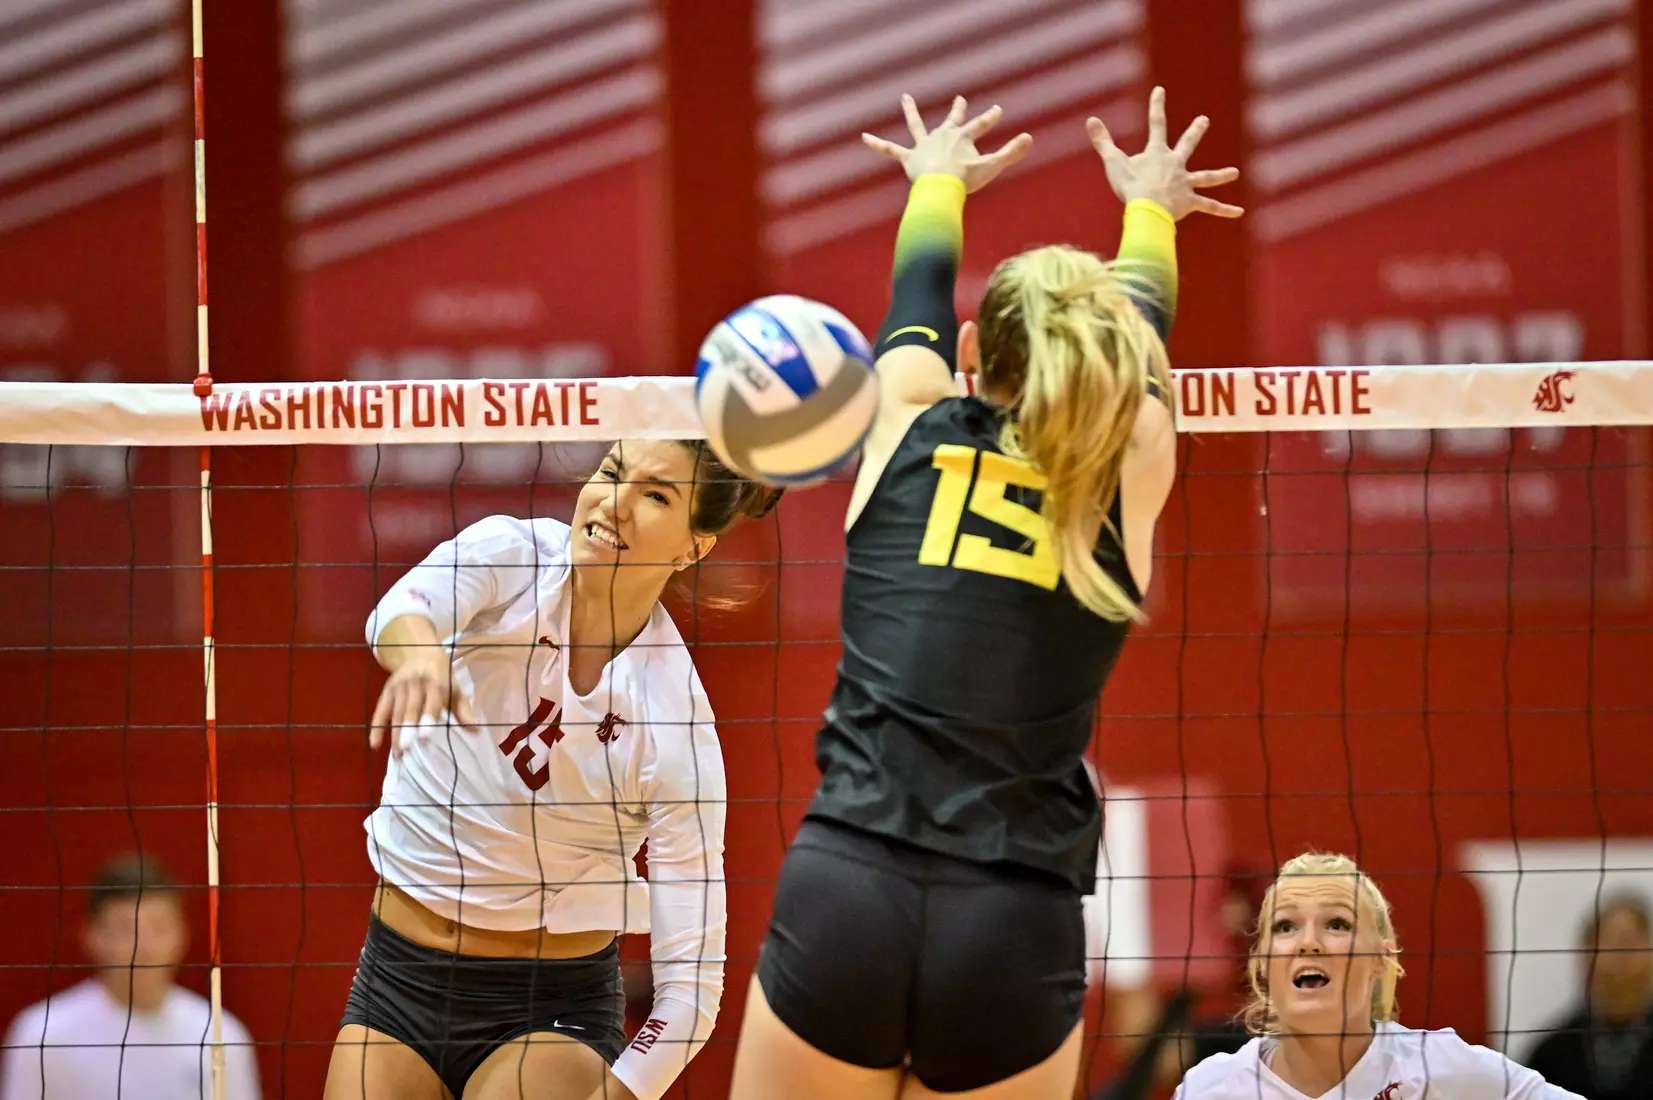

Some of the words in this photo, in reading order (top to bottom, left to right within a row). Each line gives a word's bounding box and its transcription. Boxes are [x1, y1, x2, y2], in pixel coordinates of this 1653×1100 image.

[201, 383, 465, 431] WASHINGTON
[483, 381, 600, 427] STATE
[1253, 370, 1371, 415] STATE
[917, 443, 1062, 591] 15
[498, 696, 565, 790] 15
[631, 1018, 668, 1055] WSU
